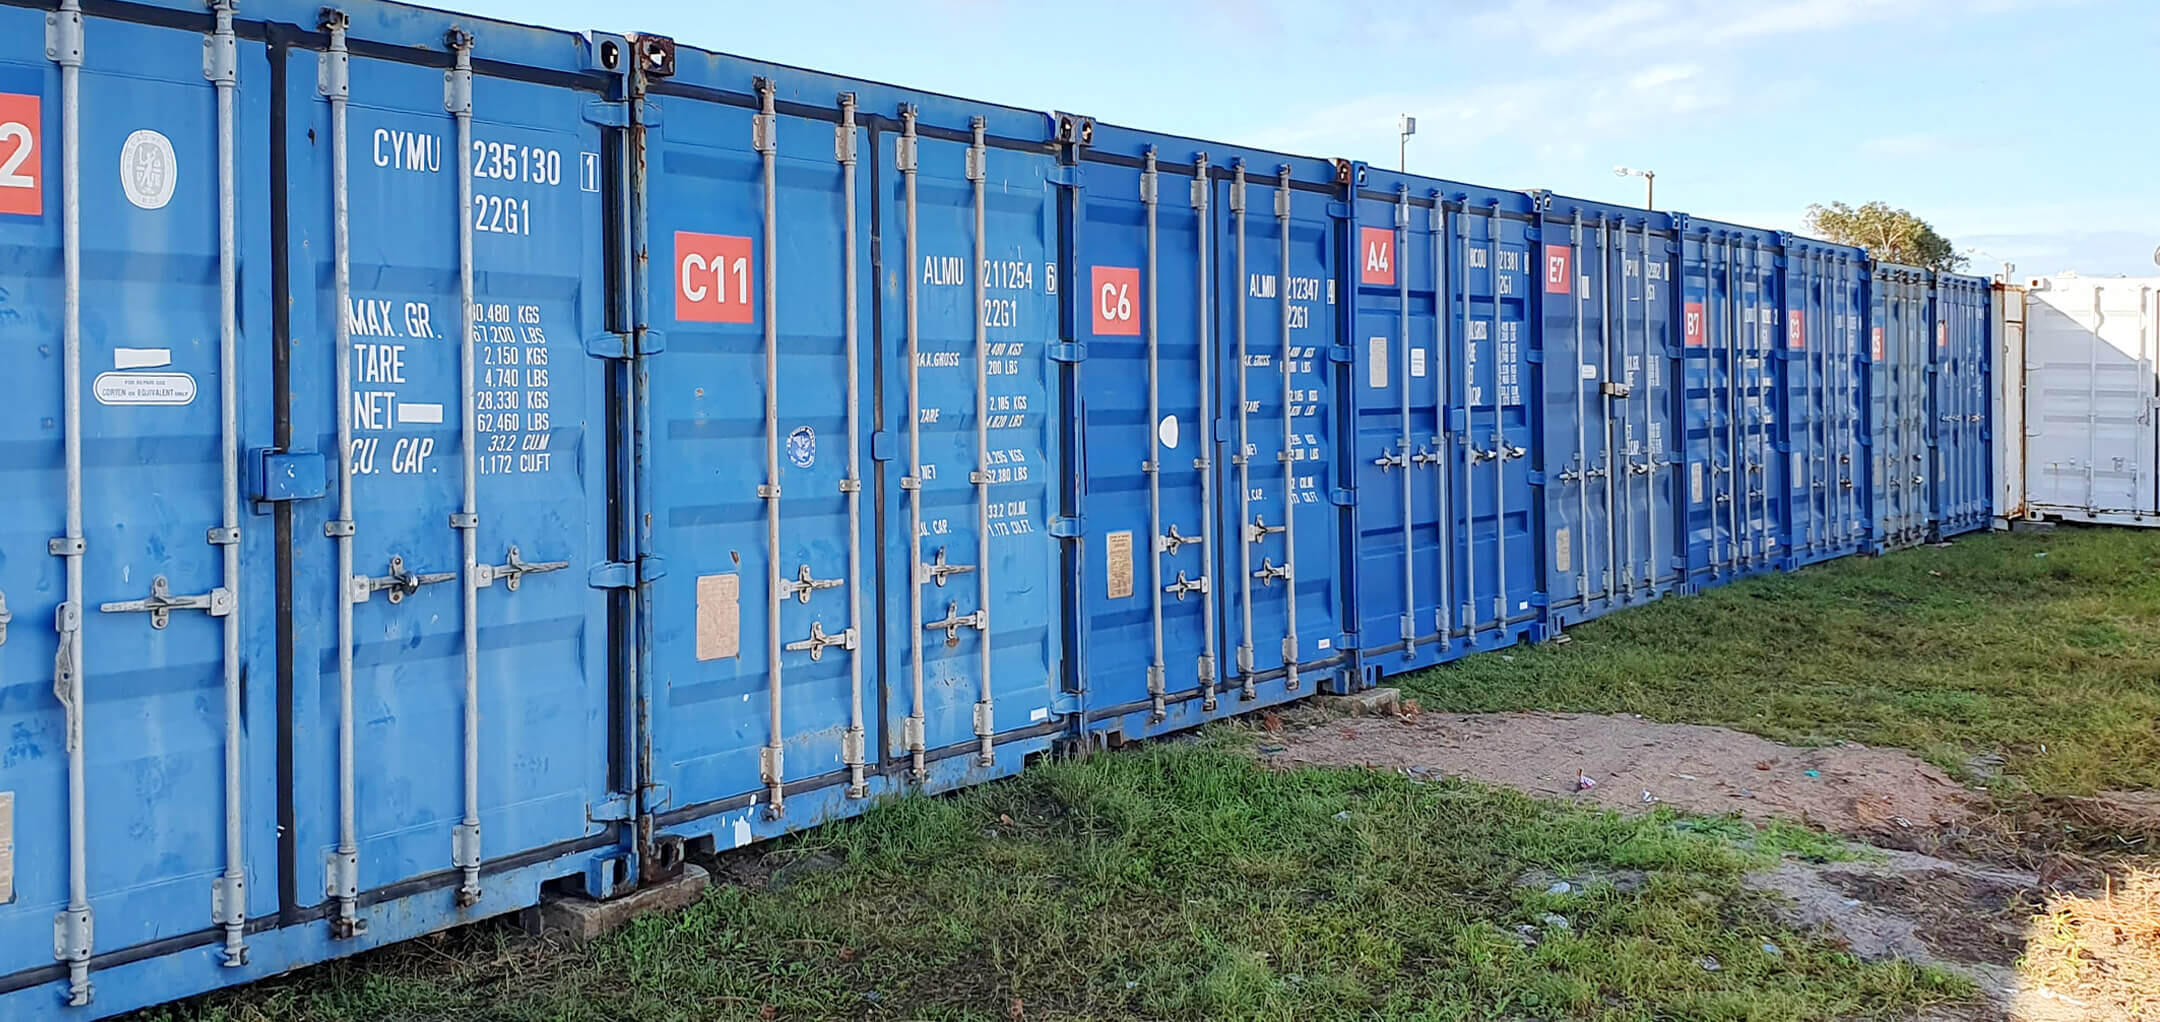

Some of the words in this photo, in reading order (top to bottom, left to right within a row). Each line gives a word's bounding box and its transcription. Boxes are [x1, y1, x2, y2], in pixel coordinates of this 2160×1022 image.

[374, 128, 441, 172] CYMU
[473, 140, 561, 186] 235130
[583, 153, 597, 191] 1
[475, 195, 530, 235] 22G1
[1366, 241, 1389, 272] A4
[1549, 256, 1565, 283] E7
[681, 253, 747, 304] C11
[923, 256, 964, 285] ALMU
[984, 260, 1033, 289] 211254
[1047, 264, 1056, 293] 6
[1249, 274, 1276, 298] ALMU
[518, 305, 540, 324] KGS
[984, 299, 1017, 327] 22G1
[1101, 282, 1131, 321] C6
[520, 326, 546, 344] LBS
[1687, 312, 1700, 336] B7
[354, 344, 406, 383] TARE
[526, 347, 548, 366] KGS
[1005, 360, 1018, 375] LBS
[527, 369, 549, 387] LBS
[354, 391, 396, 430] NET
[527, 391, 549, 409] KGS
[1013, 396, 1028, 410] KGS
[528, 413, 550, 431] LBS
[392, 437, 437, 474] CAP.
[487, 434, 517, 452] 33.2
[1014, 466, 1028, 481] LBS
